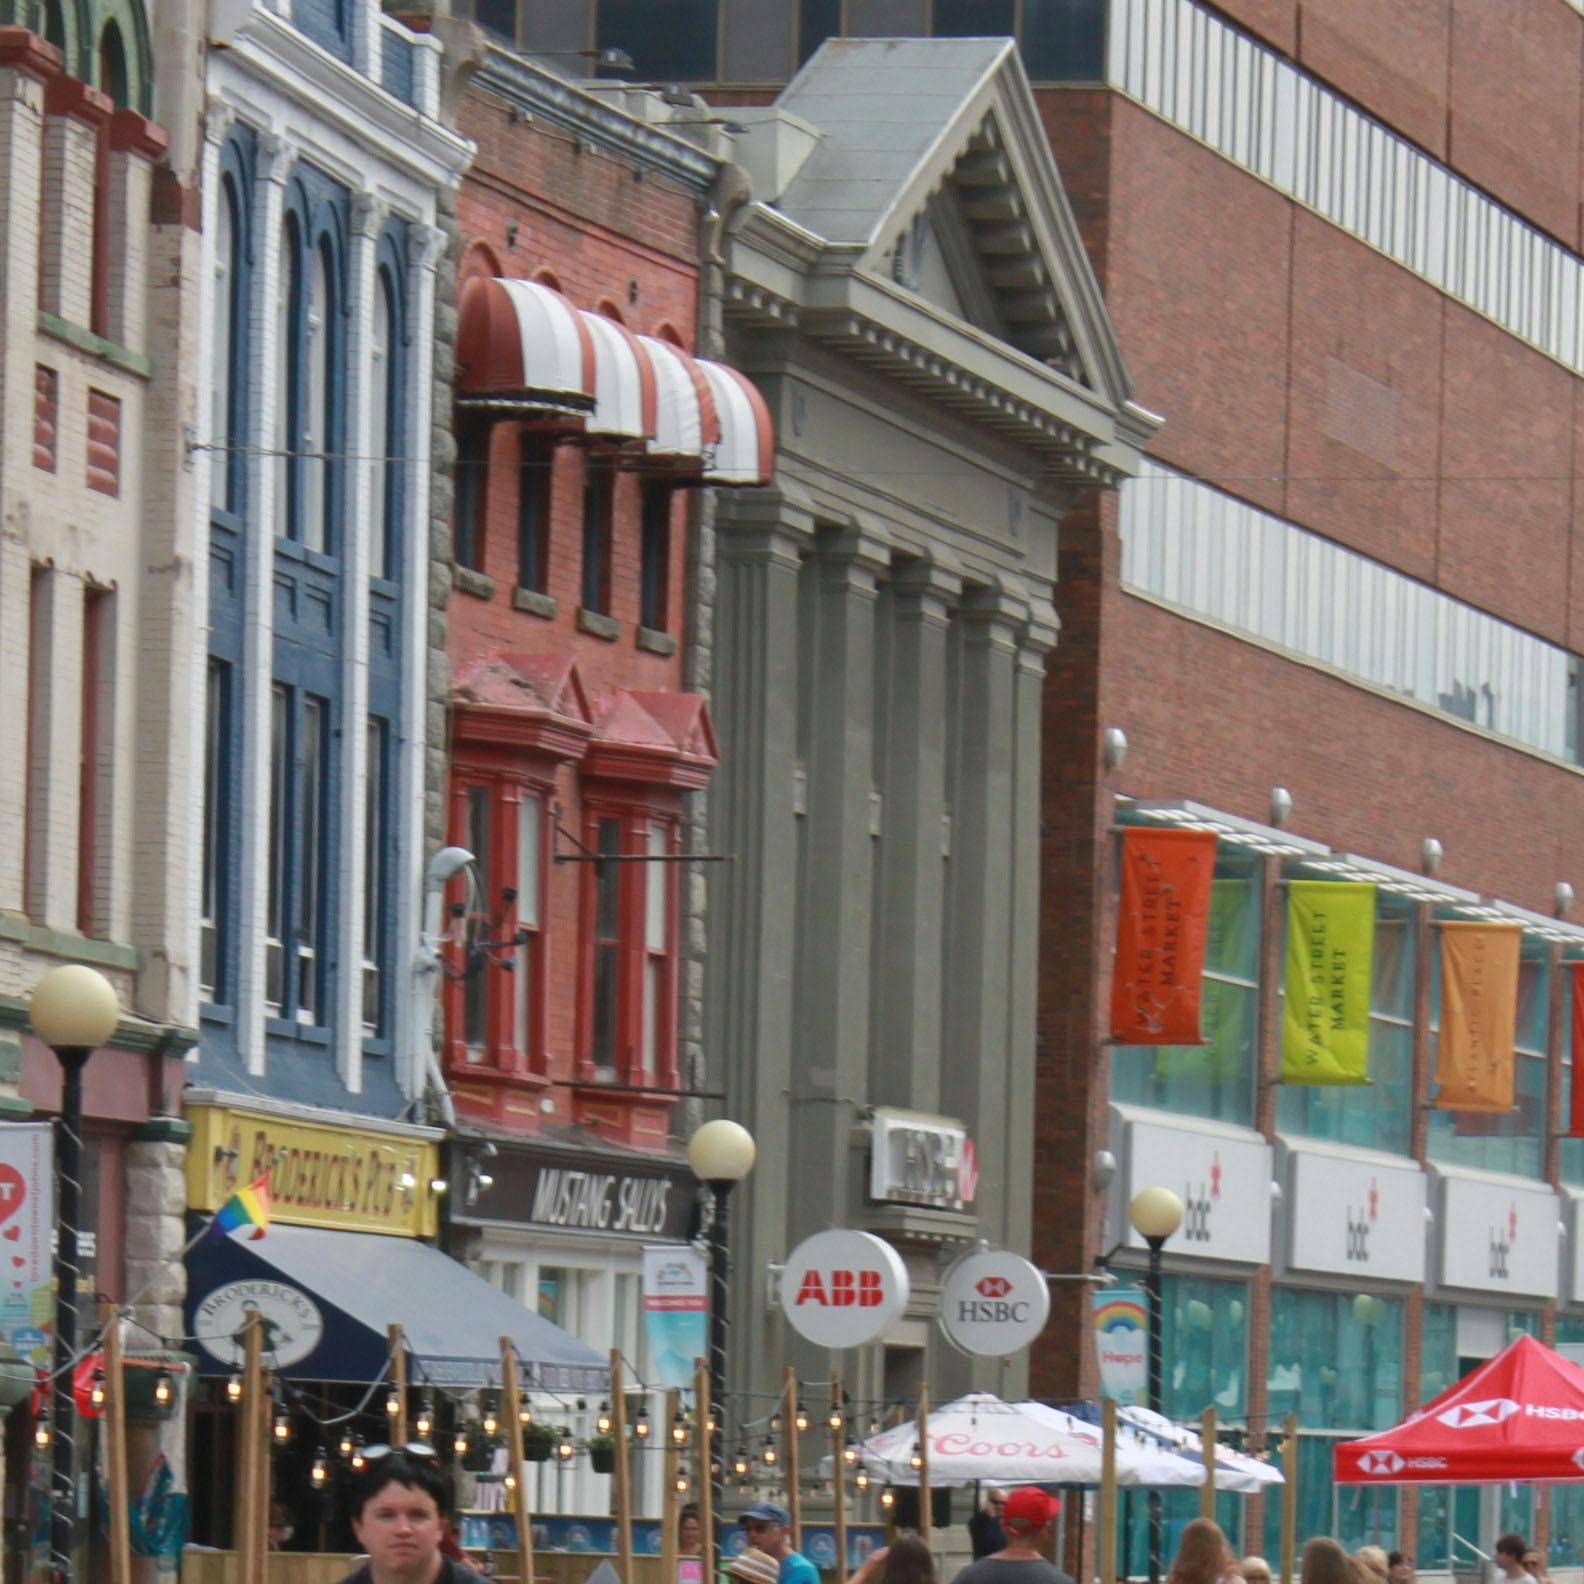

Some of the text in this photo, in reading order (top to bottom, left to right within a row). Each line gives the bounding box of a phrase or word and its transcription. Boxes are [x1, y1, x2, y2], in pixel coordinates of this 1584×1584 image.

[1160, 900, 1182, 986] MARKET
[1306, 911, 1327, 1066] WATER STREET
[1331, 949, 1347, 1030] MARKET
[530, 1167, 617, 1228] MUSTANG
[1185, 1180, 1212, 1242] bdc
[1347, 1204, 1370, 1262] bdc
[794, 1269, 886, 1307] ABB
[958, 1301, 1031, 1324] HSBC
[932, 1432, 1069, 1459] Coors
[1407, 1455, 1449, 1469] HSBC
